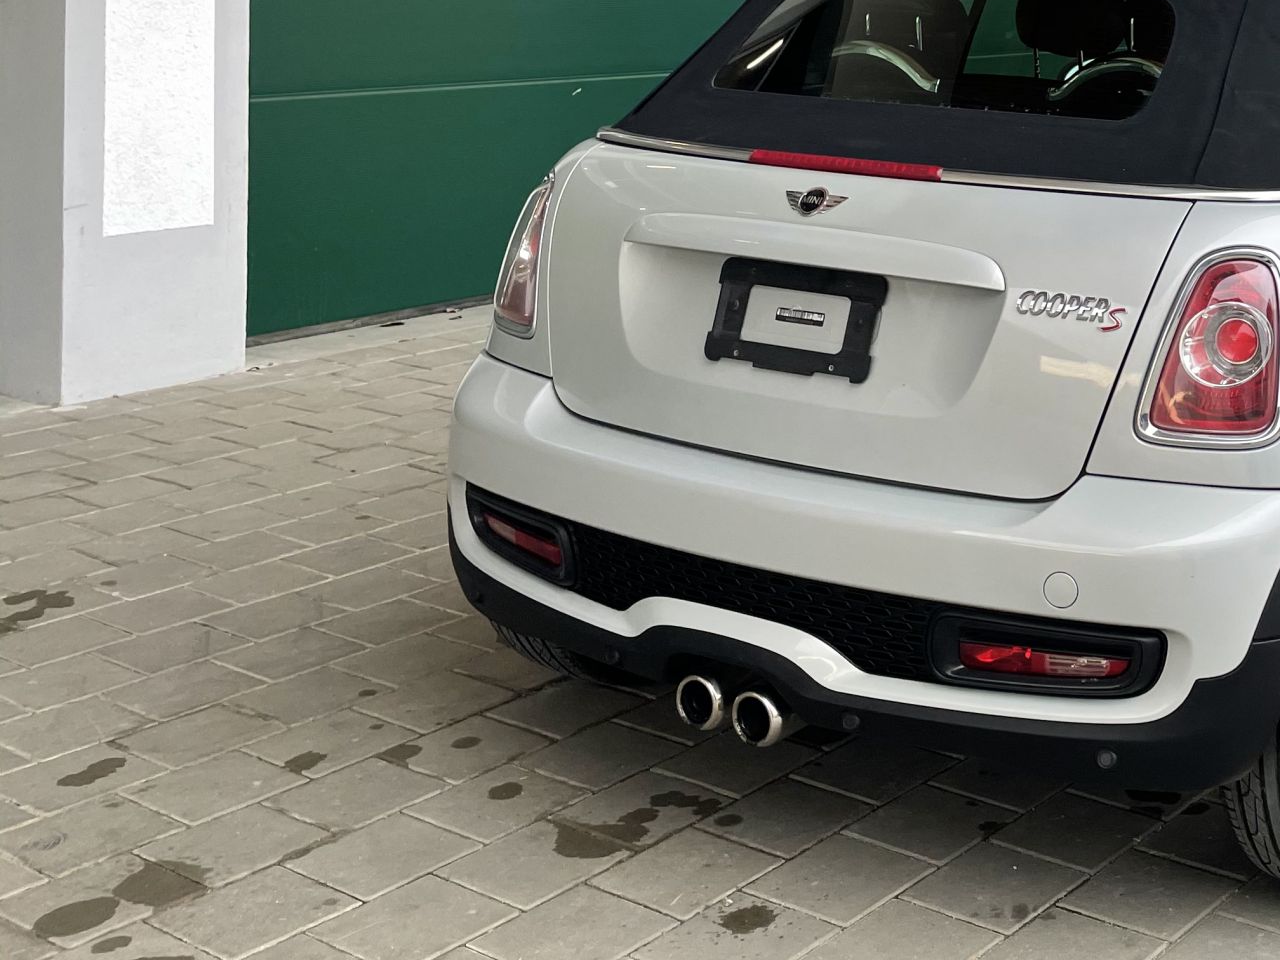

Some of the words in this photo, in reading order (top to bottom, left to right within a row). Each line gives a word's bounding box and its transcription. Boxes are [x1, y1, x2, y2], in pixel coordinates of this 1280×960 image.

[803, 195, 824, 205] MINI
[1016, 290, 1111, 324] COOPER
[1098, 307, 1128, 333] S
